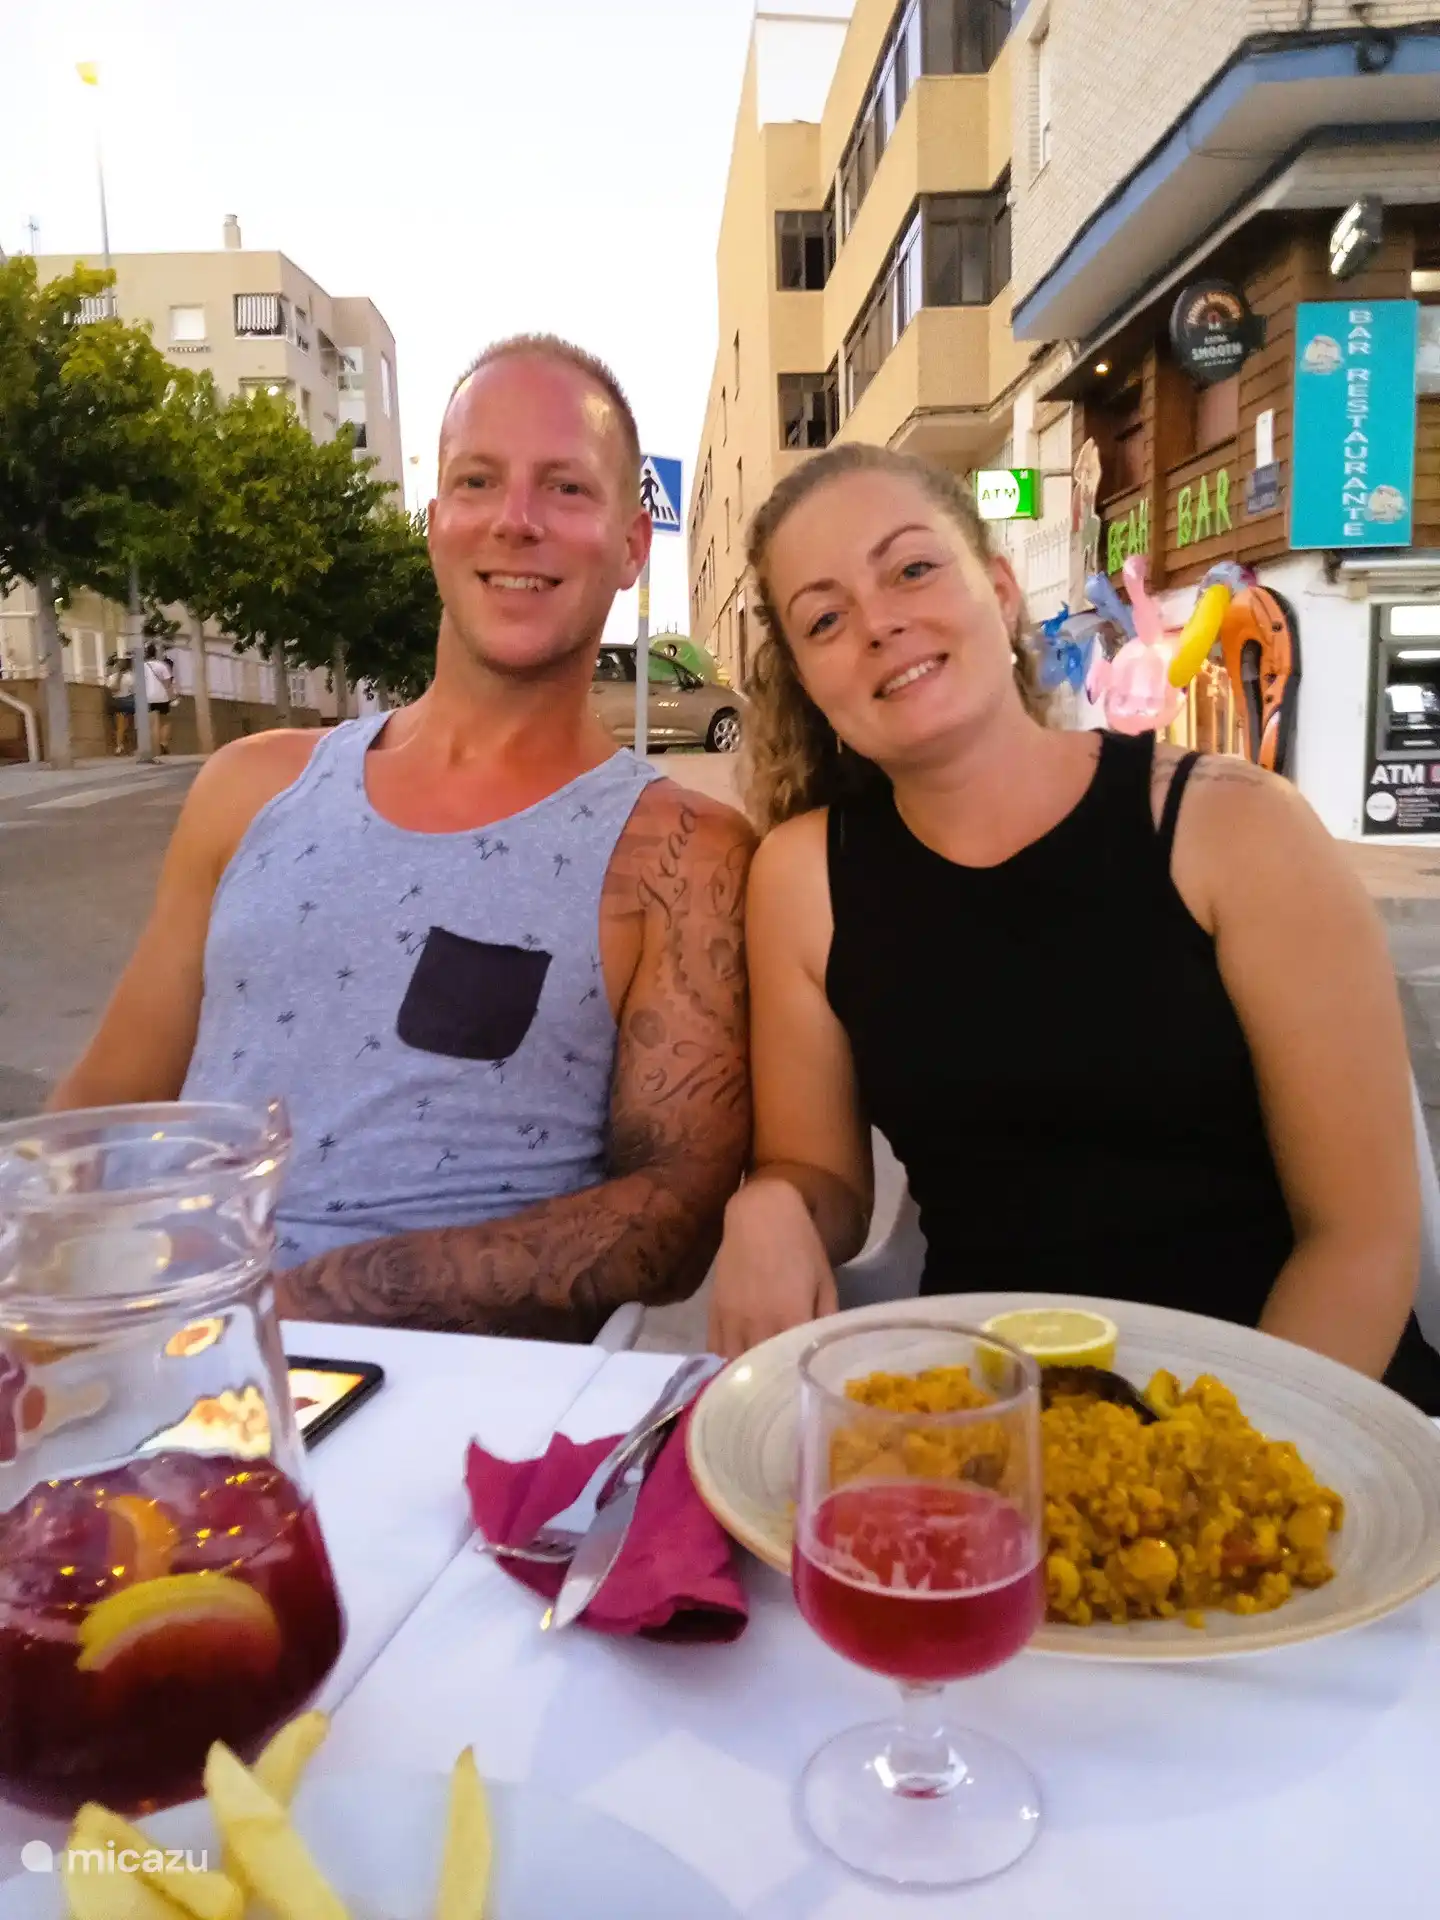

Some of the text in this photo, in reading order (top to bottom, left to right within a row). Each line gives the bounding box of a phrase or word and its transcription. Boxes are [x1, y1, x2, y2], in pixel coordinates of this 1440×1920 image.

[1191, 341, 1243, 361] SMOOTH
[1342, 309, 1374, 537] BAR RESTAURANTE
[981, 488, 1016, 500] ATM
[1177, 468, 1233, 548] BAR
[1370, 764, 1425, 785] ATM
